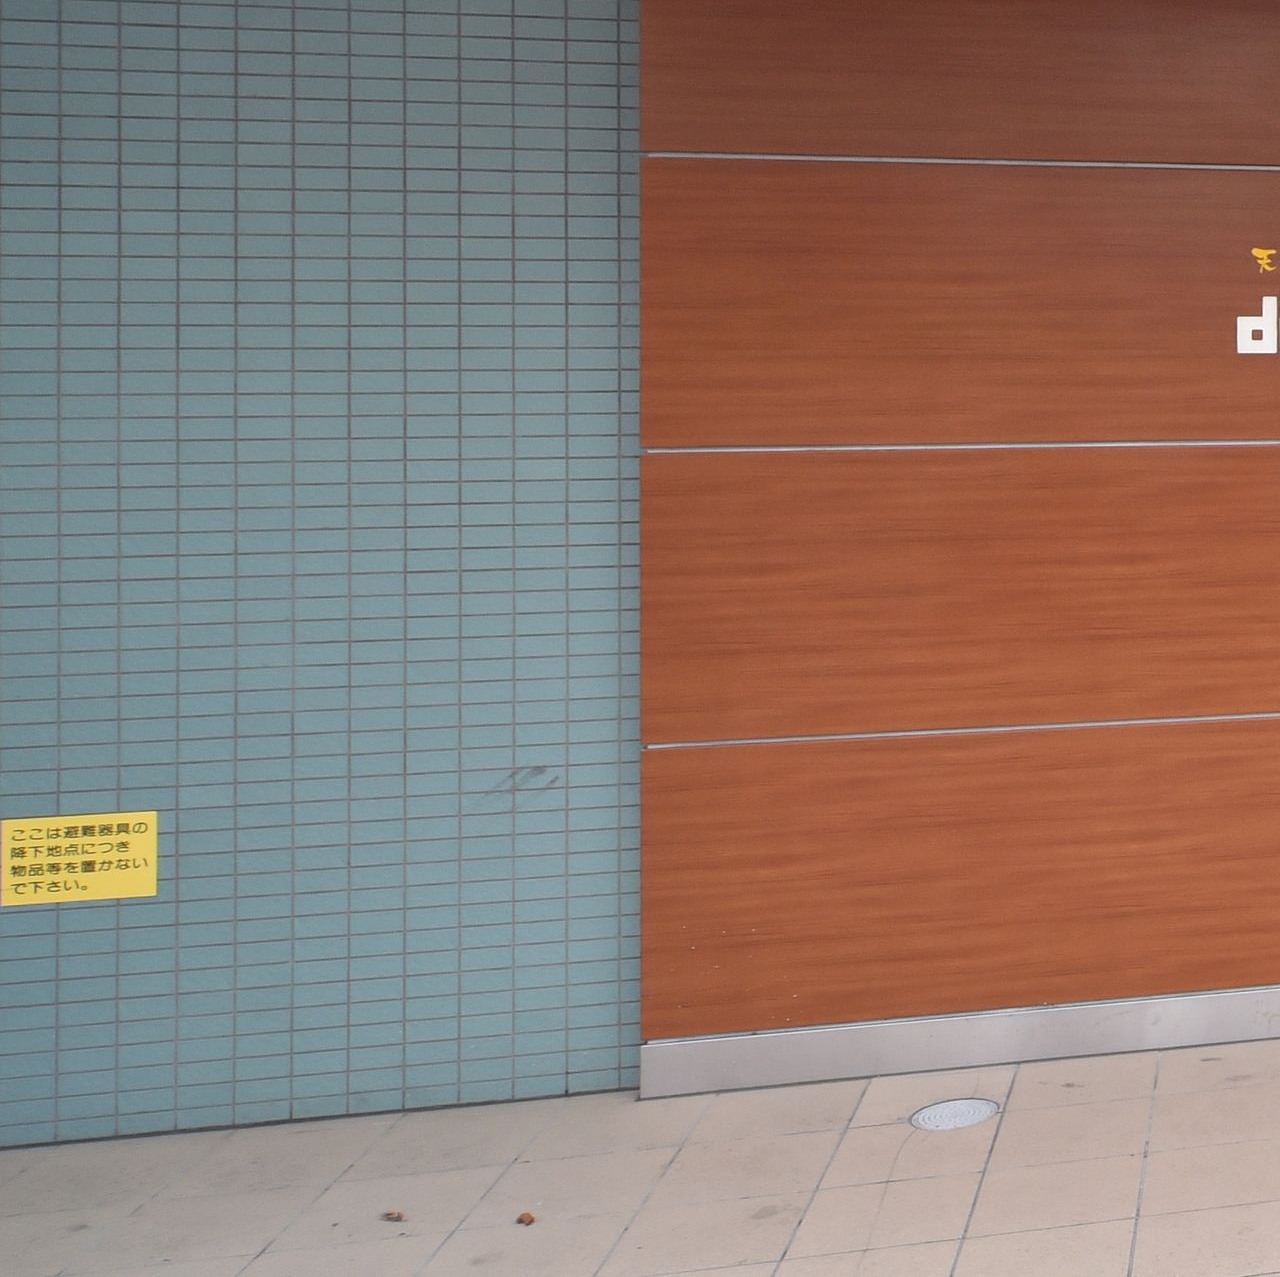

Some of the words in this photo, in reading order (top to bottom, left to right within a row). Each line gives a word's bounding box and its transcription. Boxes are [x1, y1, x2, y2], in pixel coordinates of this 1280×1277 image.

[11, 821, 149, 842] ここは避難器具の
[10, 840, 131, 860] 降下地点につき
[10, 857, 149, 878] 物品等を置かない
[11, 879, 89, 895] で下さい。
